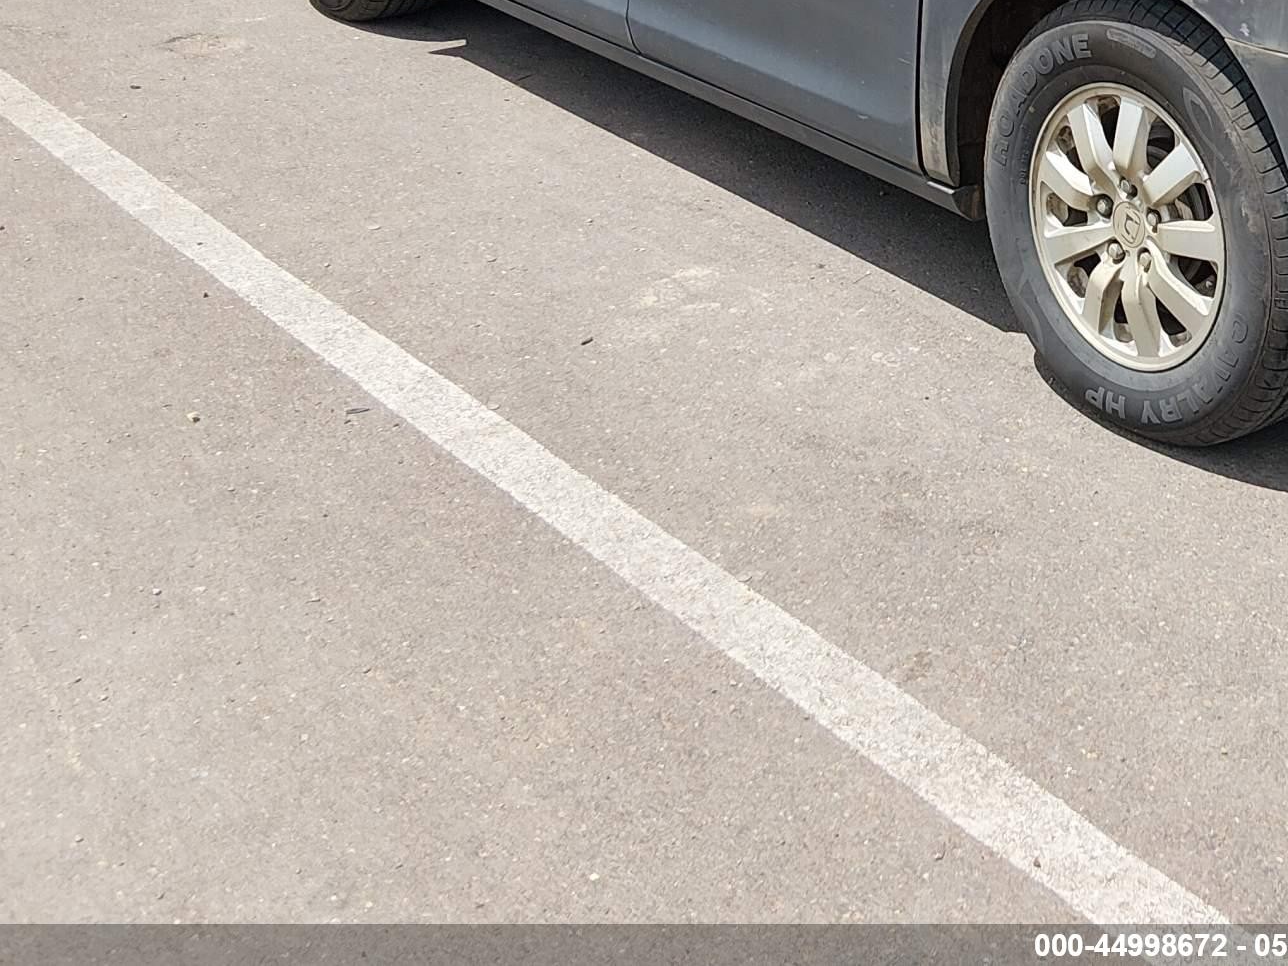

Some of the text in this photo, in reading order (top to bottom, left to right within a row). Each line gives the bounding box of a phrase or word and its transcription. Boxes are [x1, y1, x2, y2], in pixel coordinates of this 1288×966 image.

[992, 33, 1093, 167] ROADONE
[1084, 313, 1249, 425] CAVALRY HP
